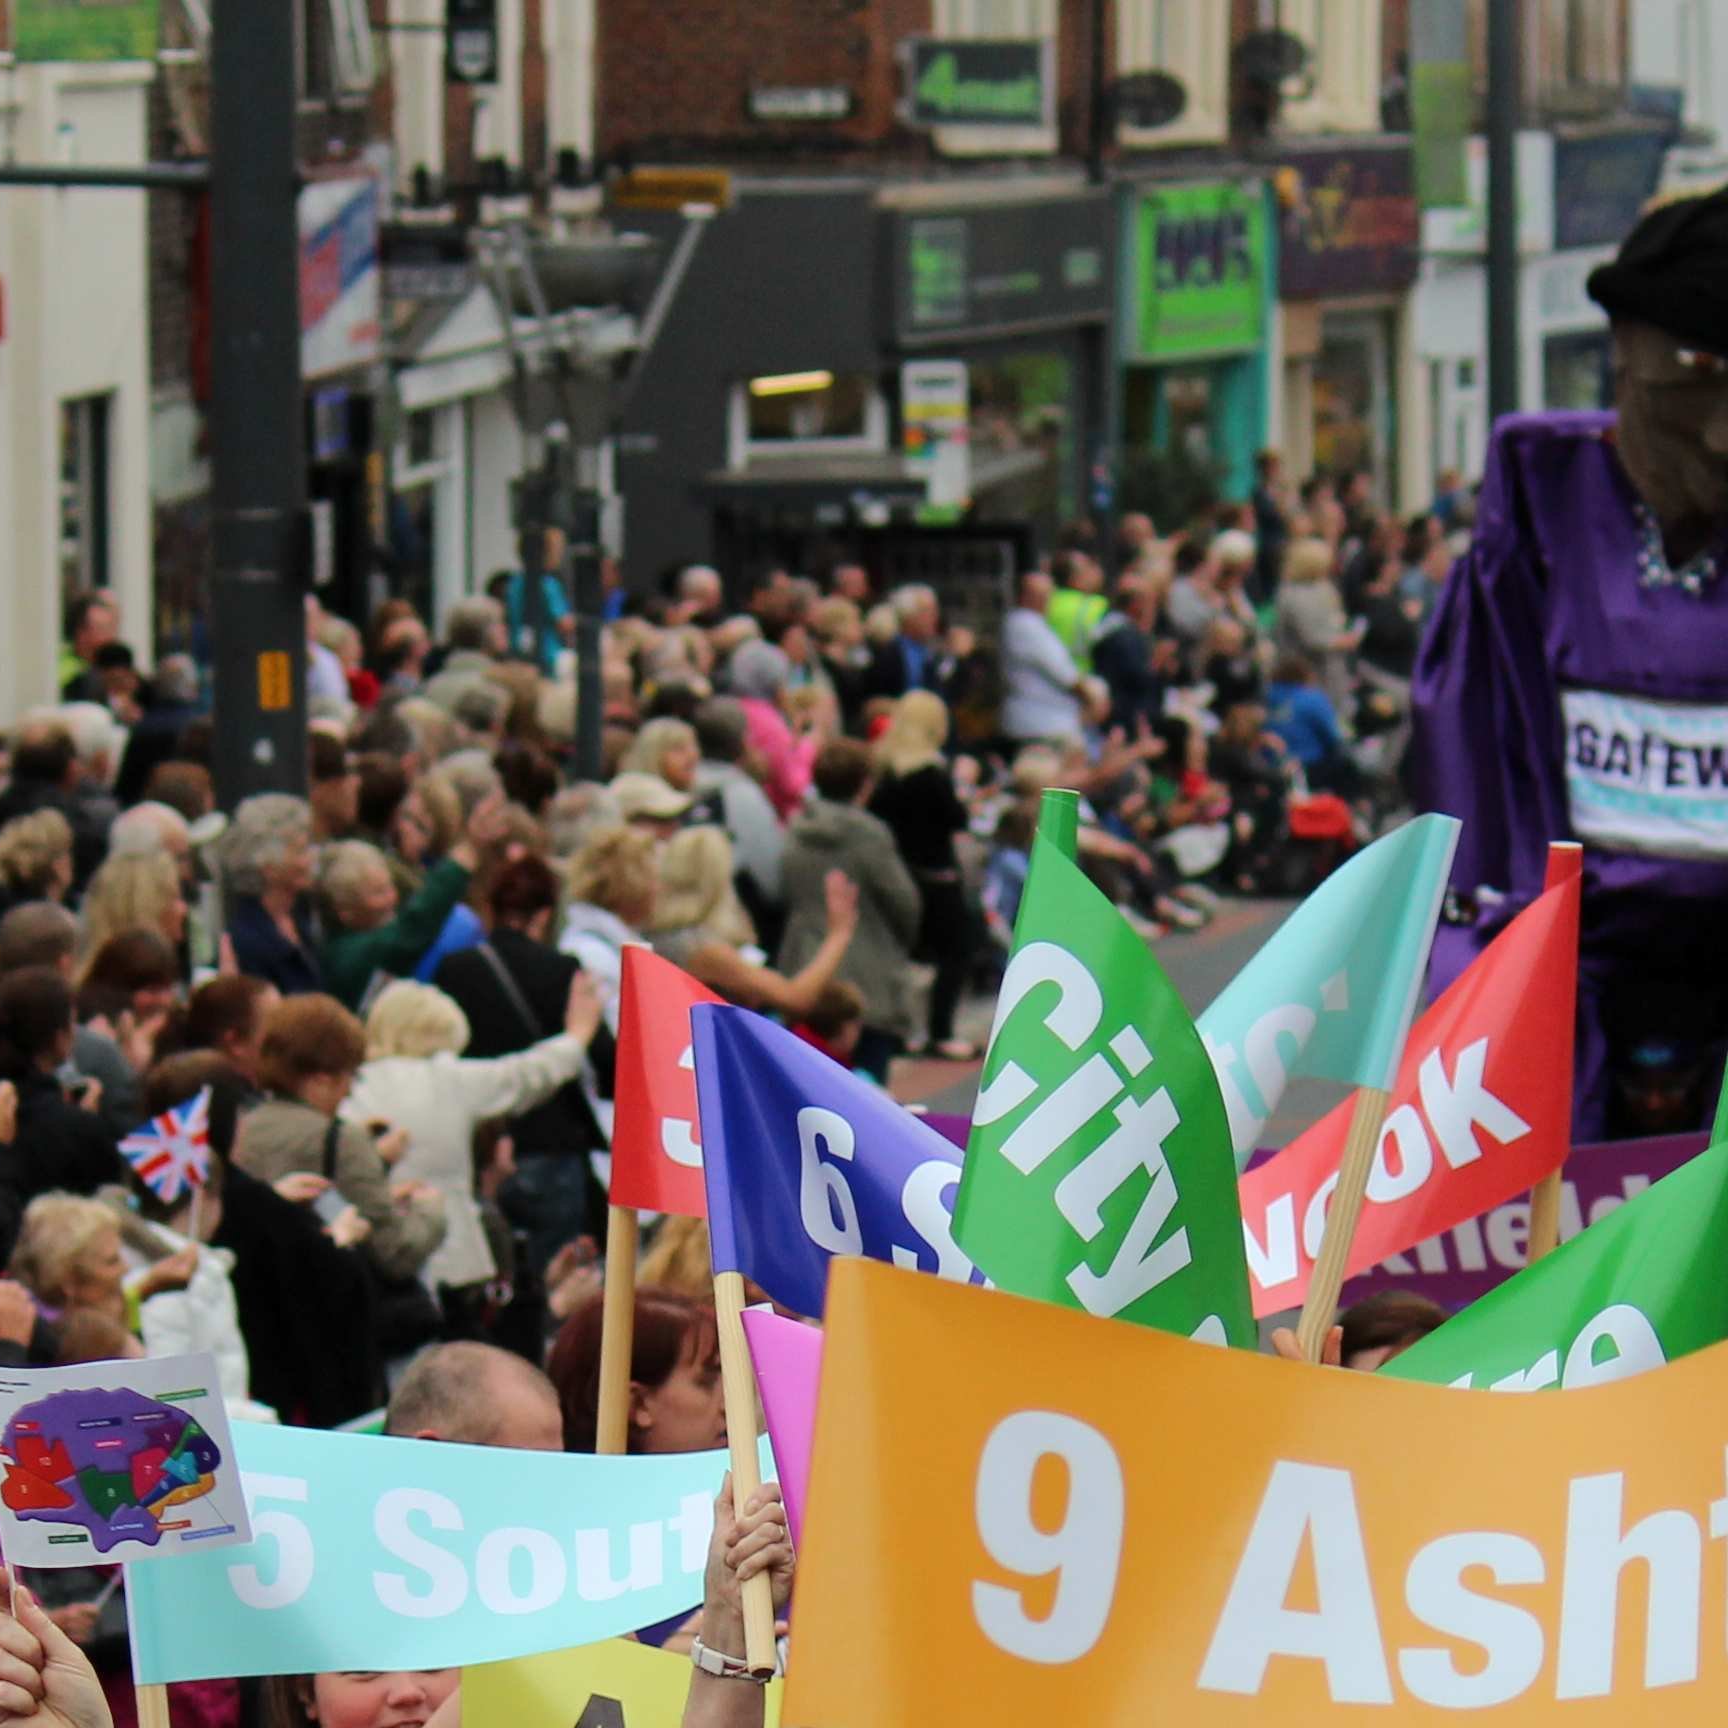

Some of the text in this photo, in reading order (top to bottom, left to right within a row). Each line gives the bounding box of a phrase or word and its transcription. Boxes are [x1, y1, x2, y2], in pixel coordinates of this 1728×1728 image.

[797, 1106, 863, 1255] 6
[971, 941, 1193, 1319] City
[227, 1471, 315, 1611] 5
[970, 1411, 1126, 1665] 9
